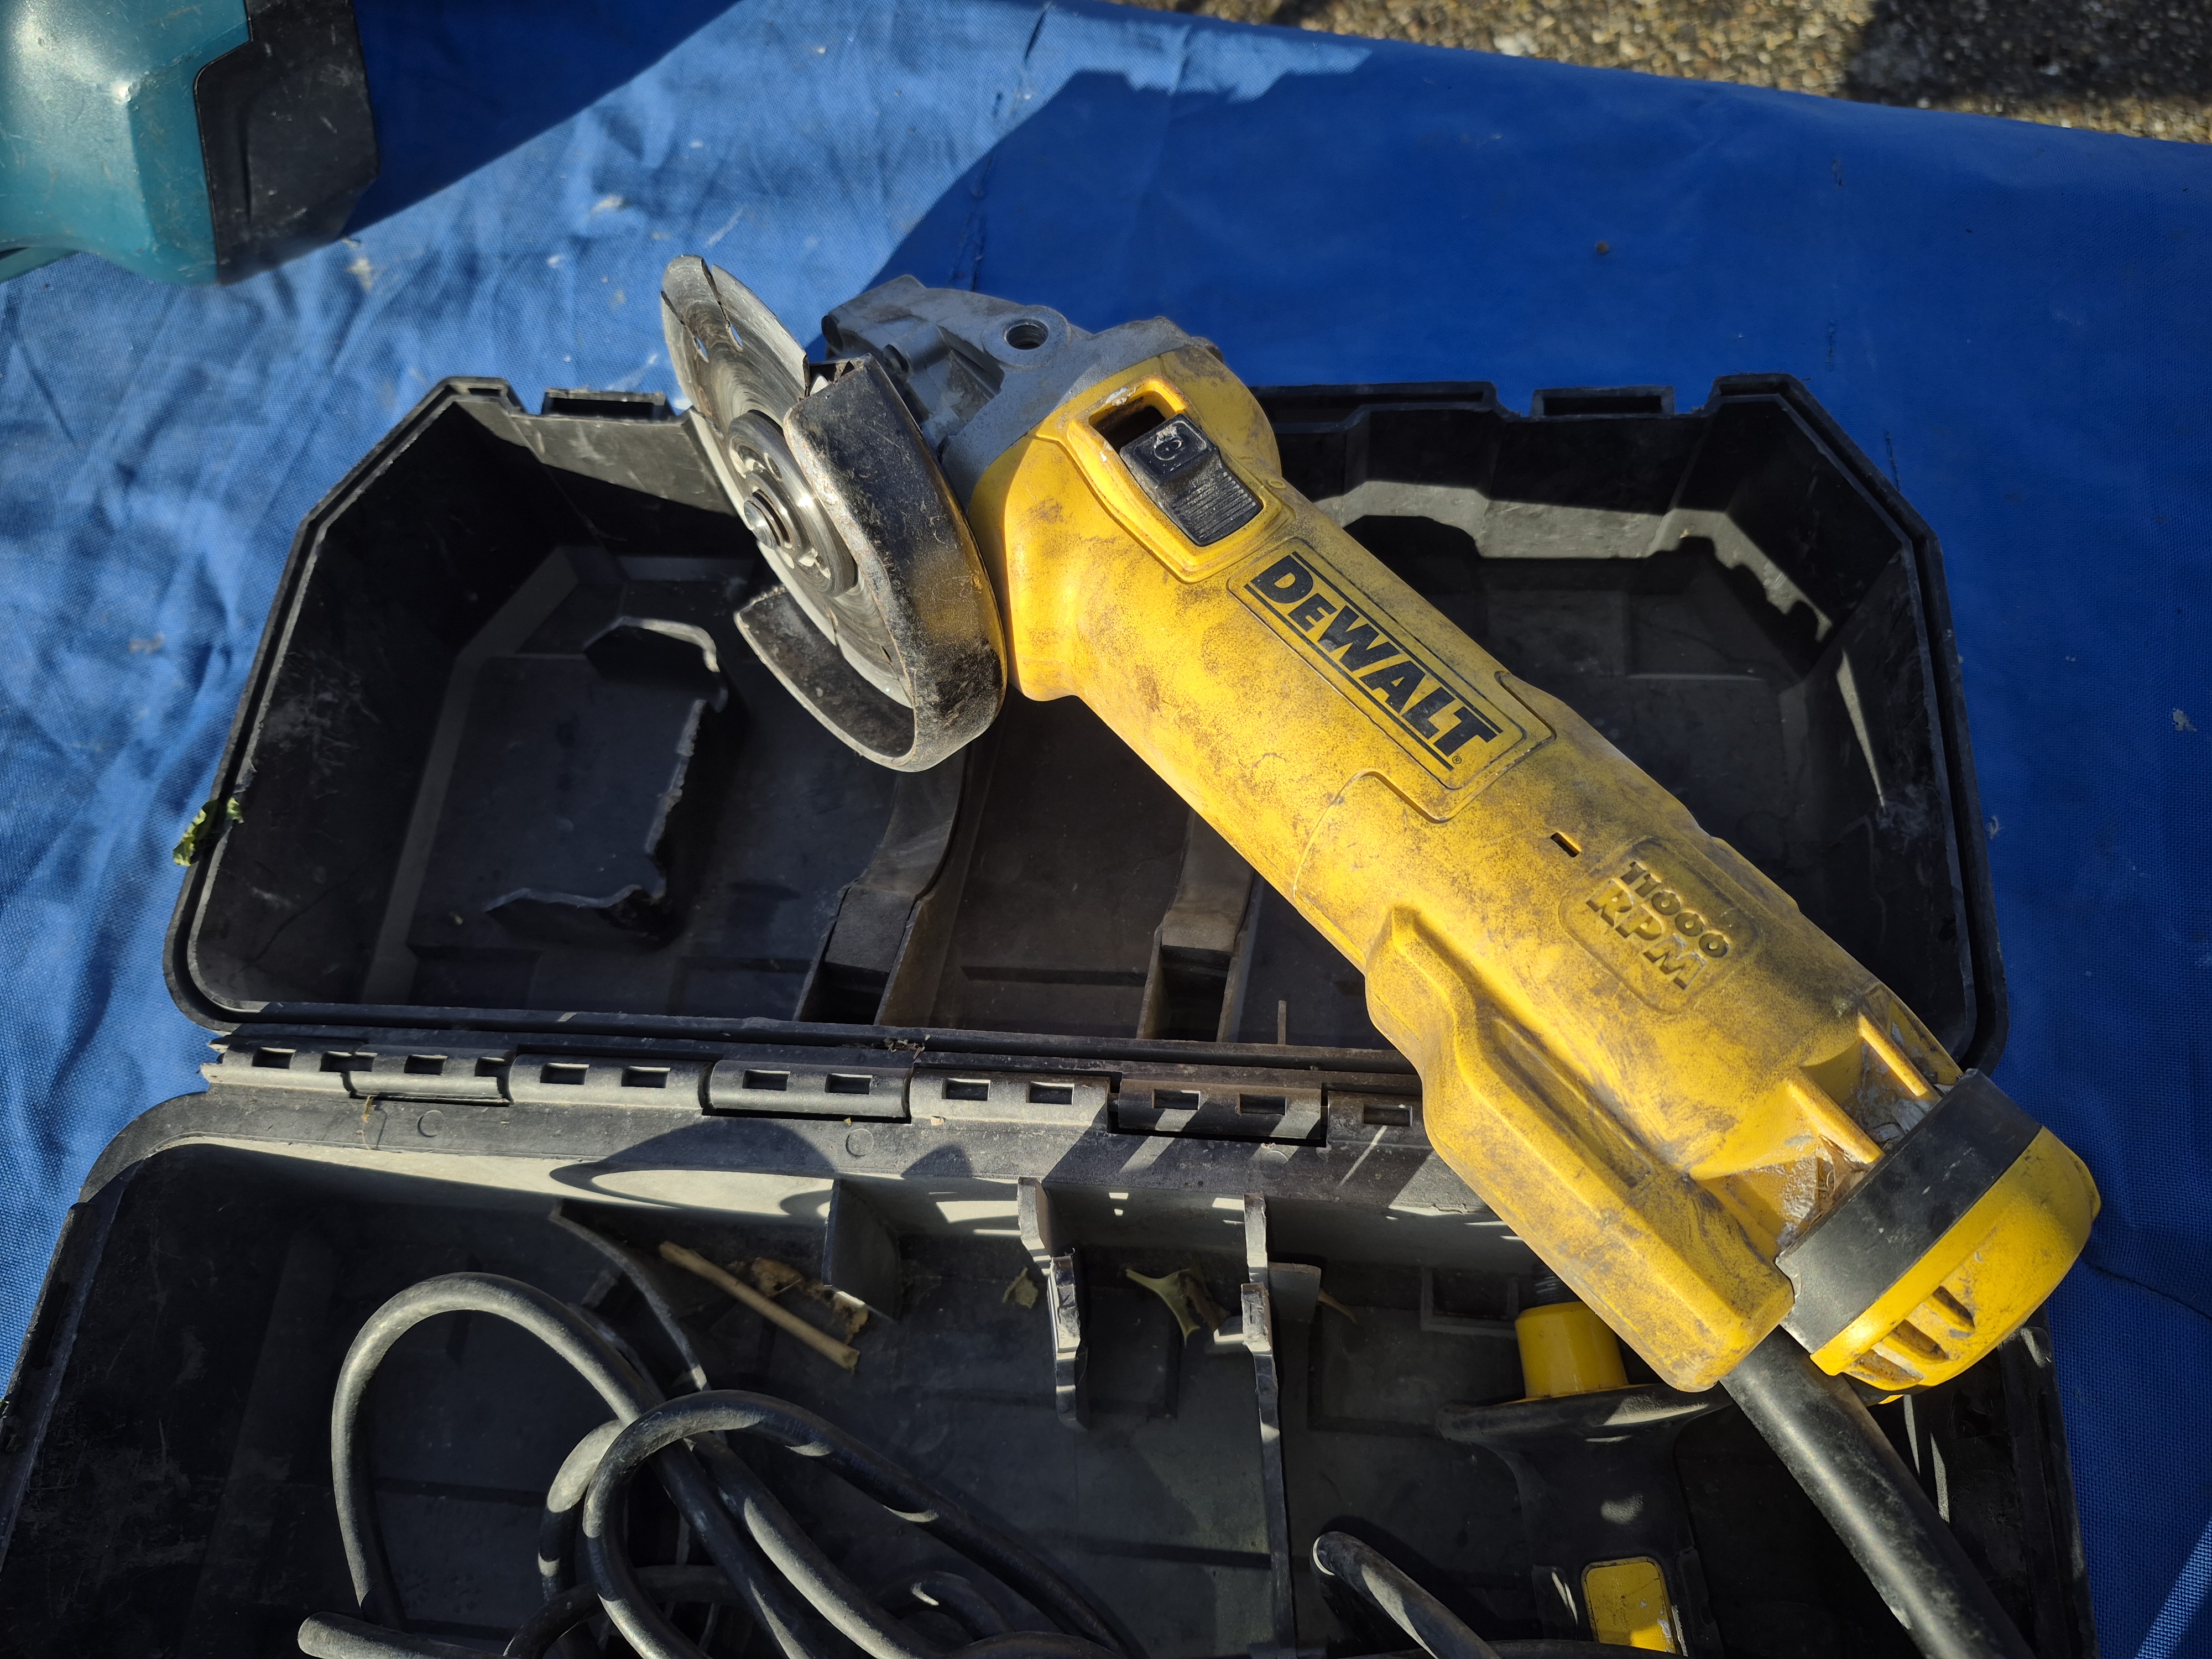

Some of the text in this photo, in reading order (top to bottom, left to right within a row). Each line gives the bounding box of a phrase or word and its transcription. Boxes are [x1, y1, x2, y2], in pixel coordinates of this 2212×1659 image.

[1250, 555, 1498, 757] DEWALT
[1585, 877, 1707, 990] RPM
[1621, 861, 1731, 958] 11000
